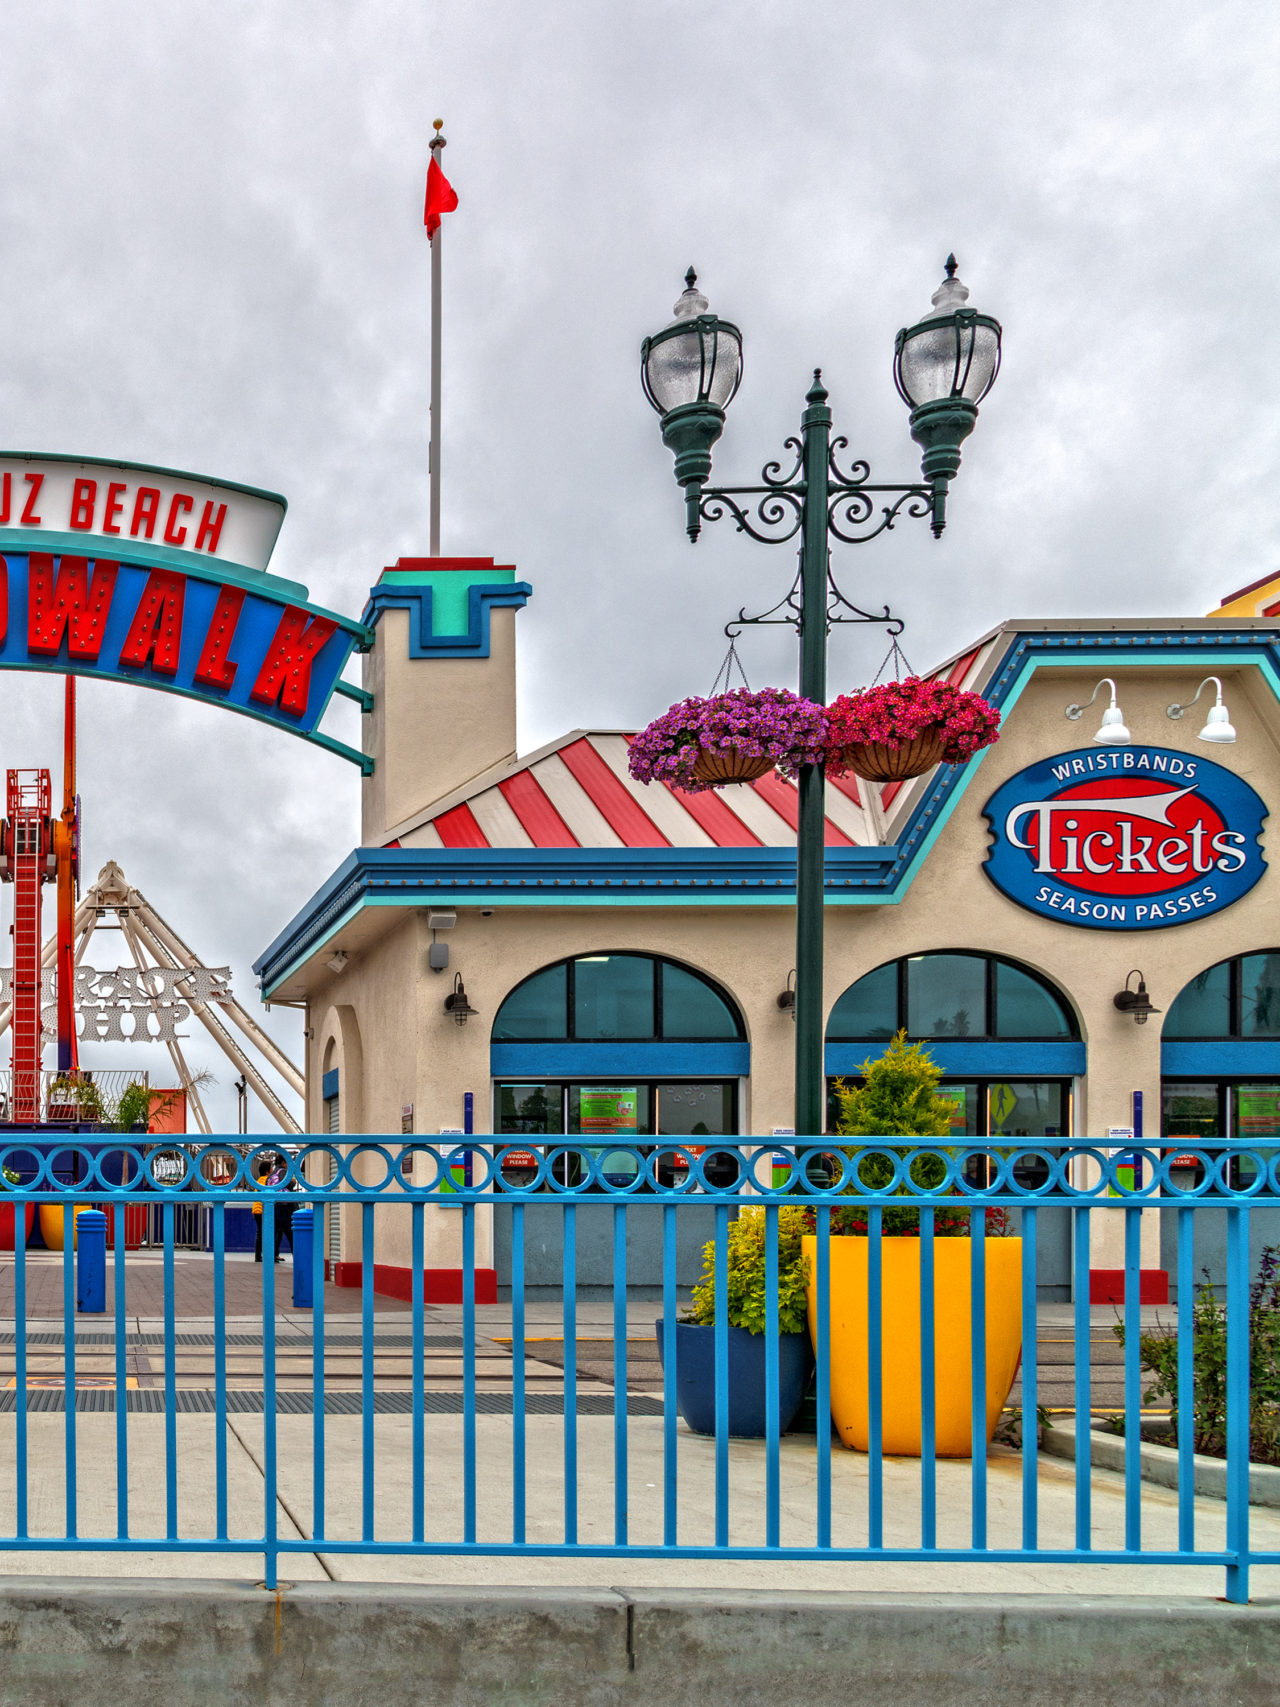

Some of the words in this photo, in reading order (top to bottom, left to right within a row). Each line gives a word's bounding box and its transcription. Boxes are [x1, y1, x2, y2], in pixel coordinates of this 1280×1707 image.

[70, 478, 227, 553] BEACH
[1051, 753, 1198, 782] WRISTBANDS
[1005, 783, 1247, 874] Tickets
[1035, 886, 1126, 921] SEASON
[1135, 886, 1218, 921] PASSES
